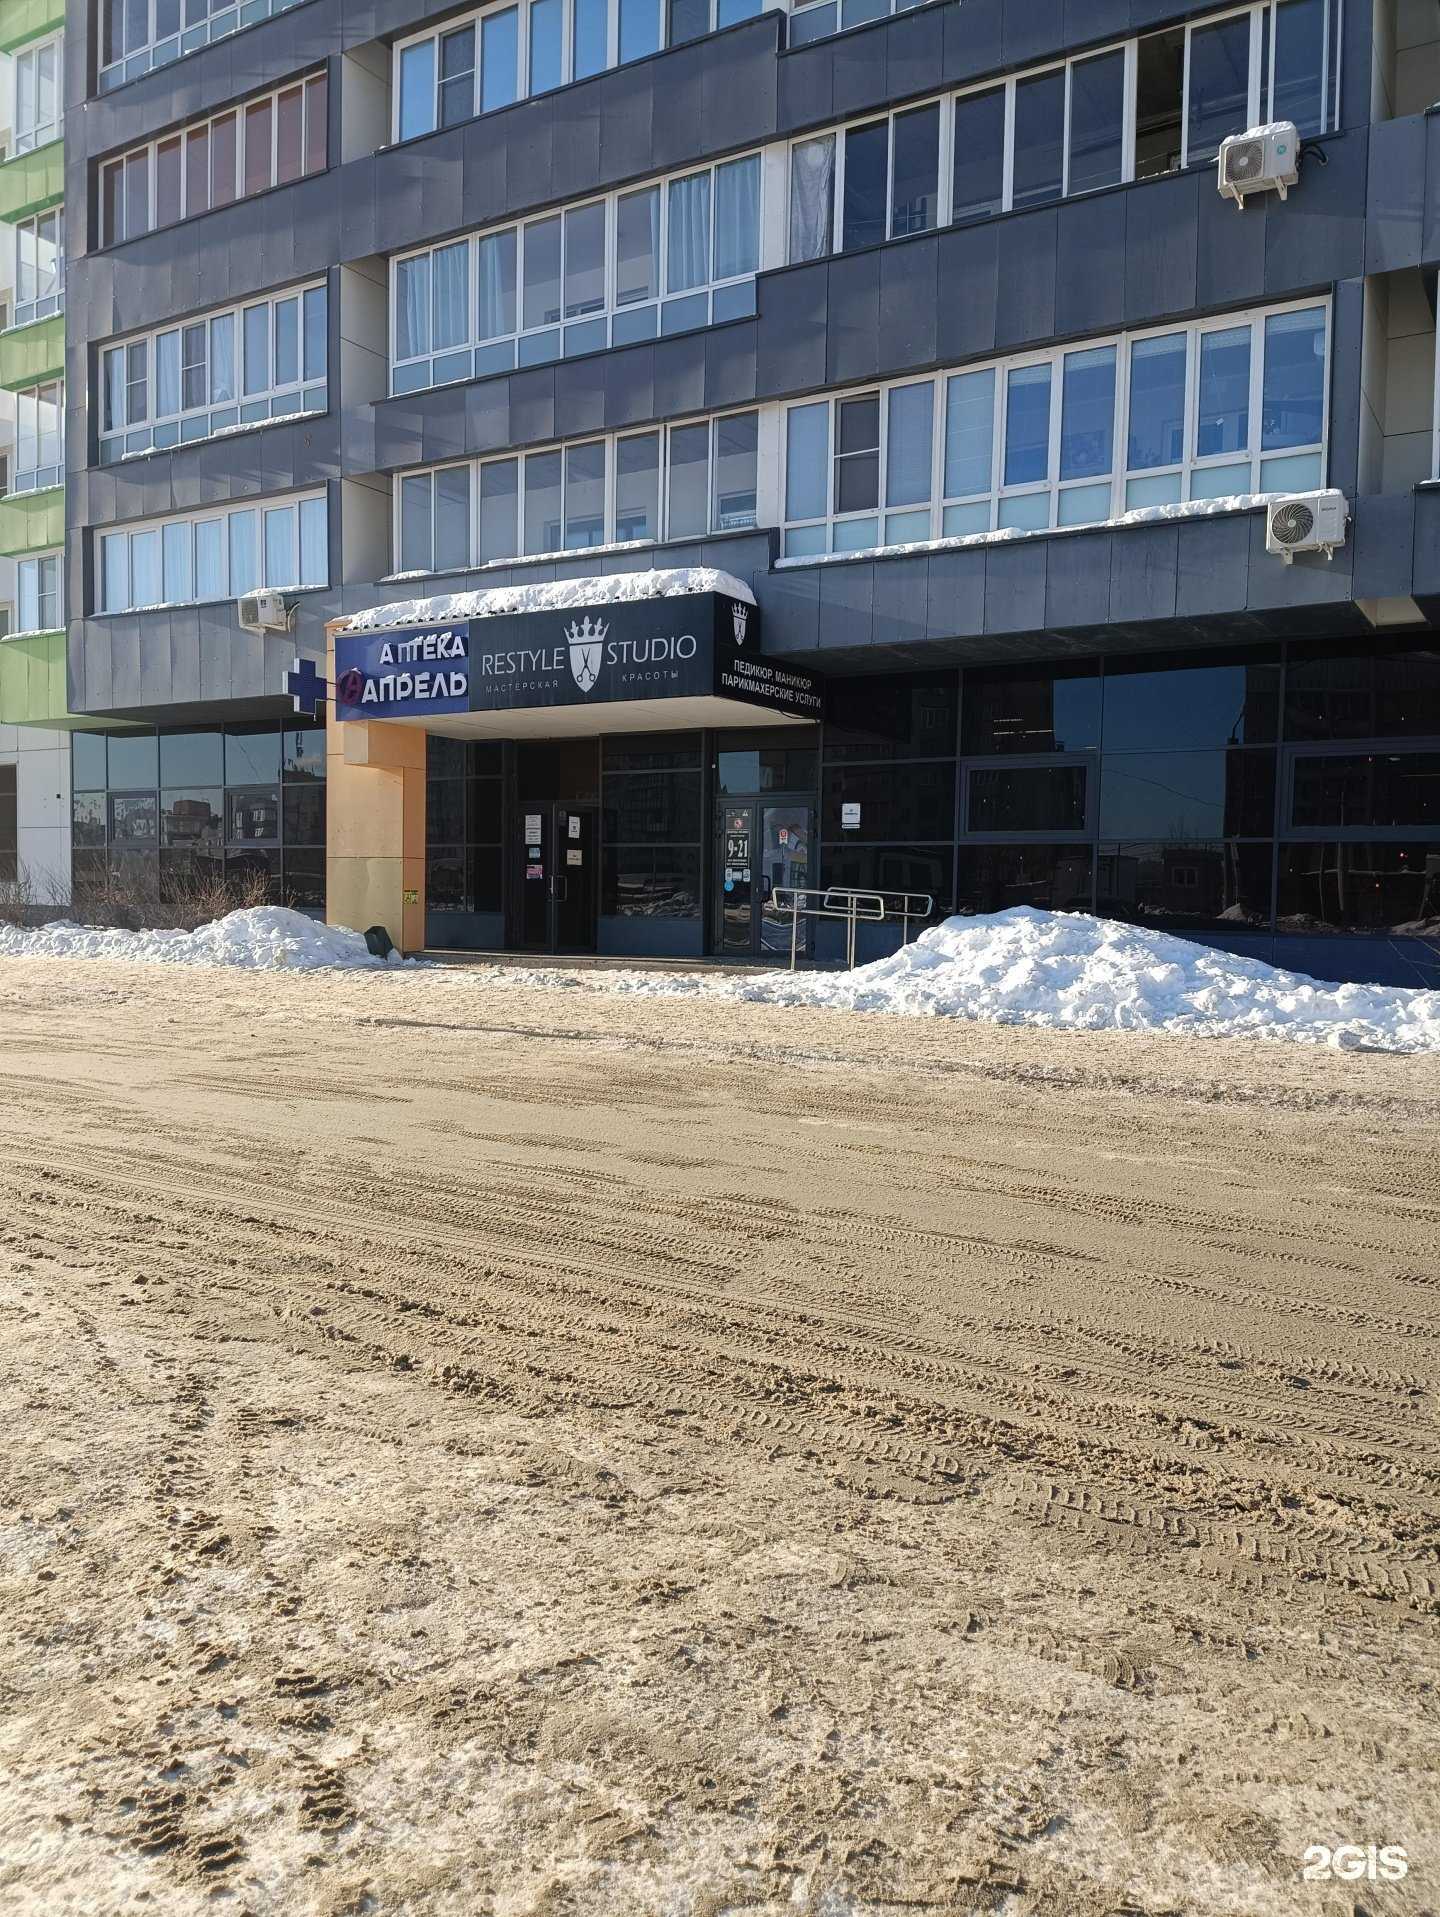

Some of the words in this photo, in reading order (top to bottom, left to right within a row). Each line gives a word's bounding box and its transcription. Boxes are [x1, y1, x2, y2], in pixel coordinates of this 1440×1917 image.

[380, 632, 466, 664] АПТЕКА
[482, 647, 565, 675] RESTYLE
[607, 635, 697, 665] STUDIO
[361, 672, 467, 704] АПРЕЛЬ
[485, 680, 559, 695] МАСТЕРСКАЯ
[621, 670, 679, 682] КРАСОТЫ
[721, 673, 794, 701] ПАРИКМАХЕРСКИЕ
[795, 692, 821, 708] УСЛУГИ
[734, 659, 774, 682] ПЕДИКЮР,
[775, 671, 812, 690] МАНИКЮР
